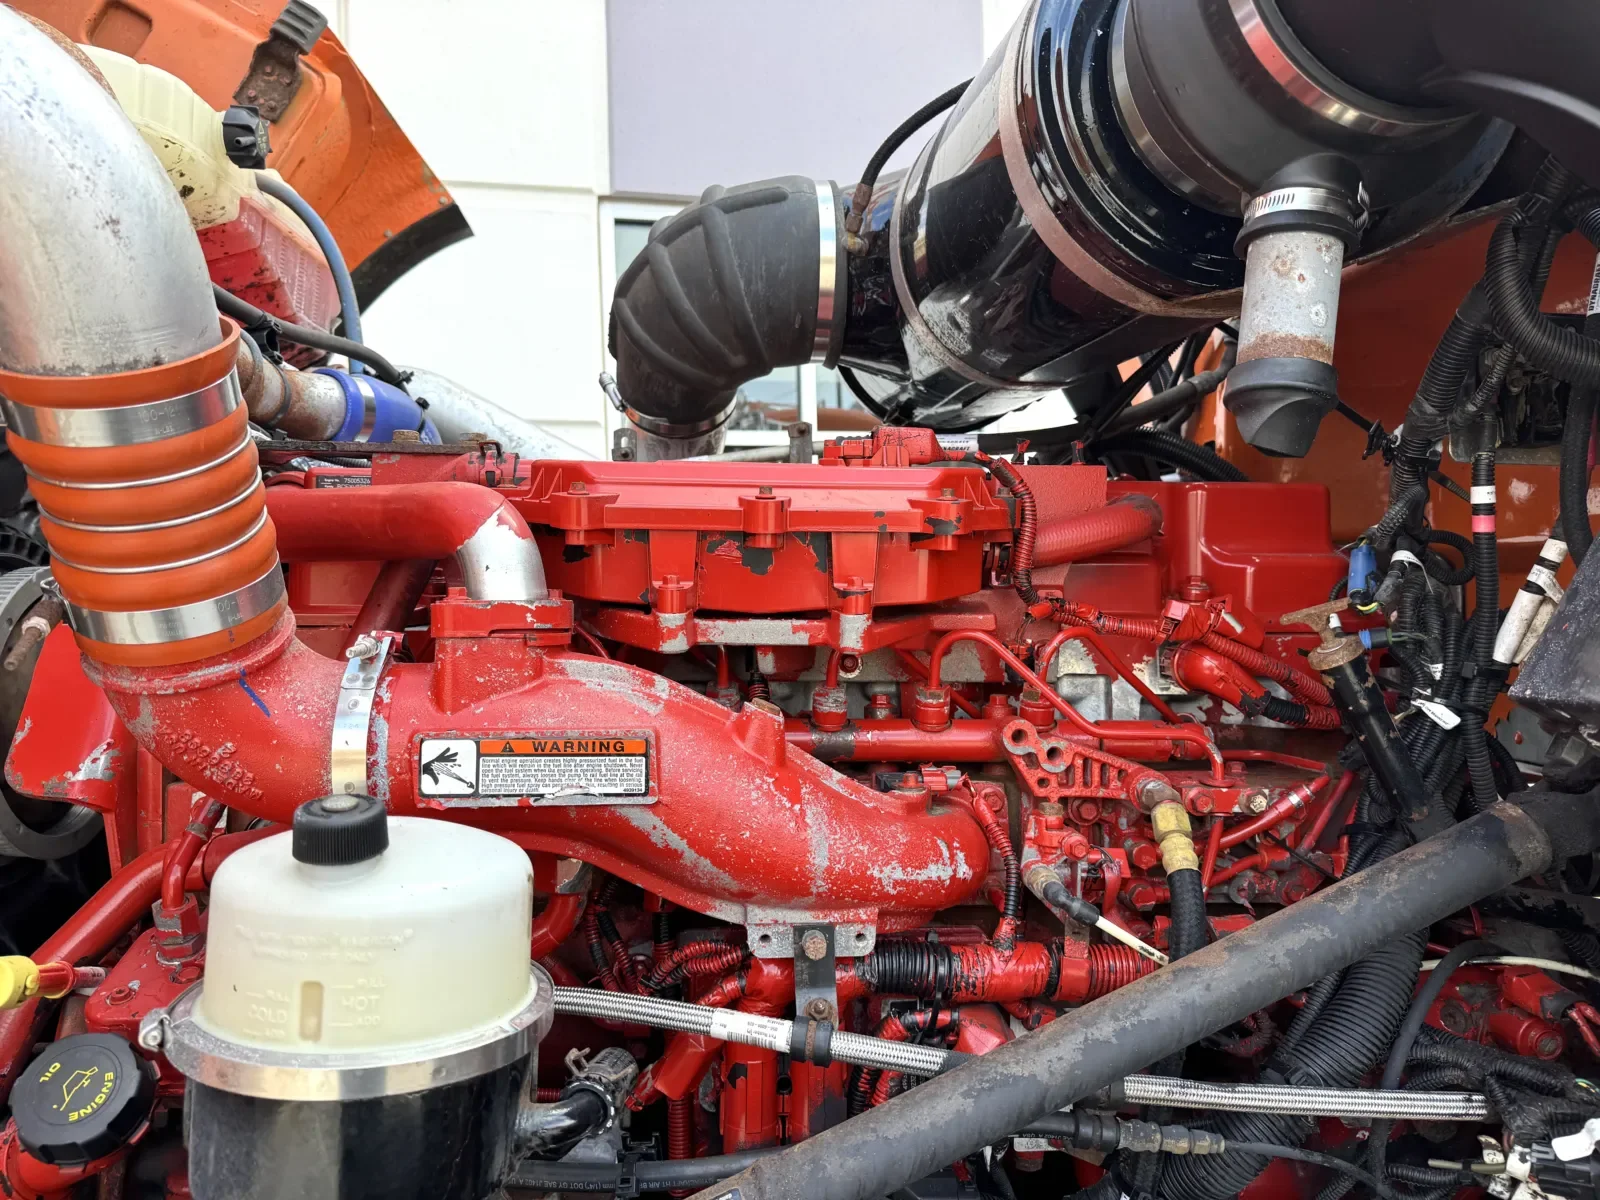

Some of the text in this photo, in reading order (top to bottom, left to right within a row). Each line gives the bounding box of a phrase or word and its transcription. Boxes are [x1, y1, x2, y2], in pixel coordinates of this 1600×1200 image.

[532, 741, 625, 753] WARNING
[341, 994, 380, 1011] HOT
[247, 1003, 288, 1024] COLD
[39, 1061, 61, 1083] OIL
[68, 1071, 114, 1122] ENGINE
[525, 1178, 542, 1187] J1402
[543, 1180, 557, 1188] SAE
